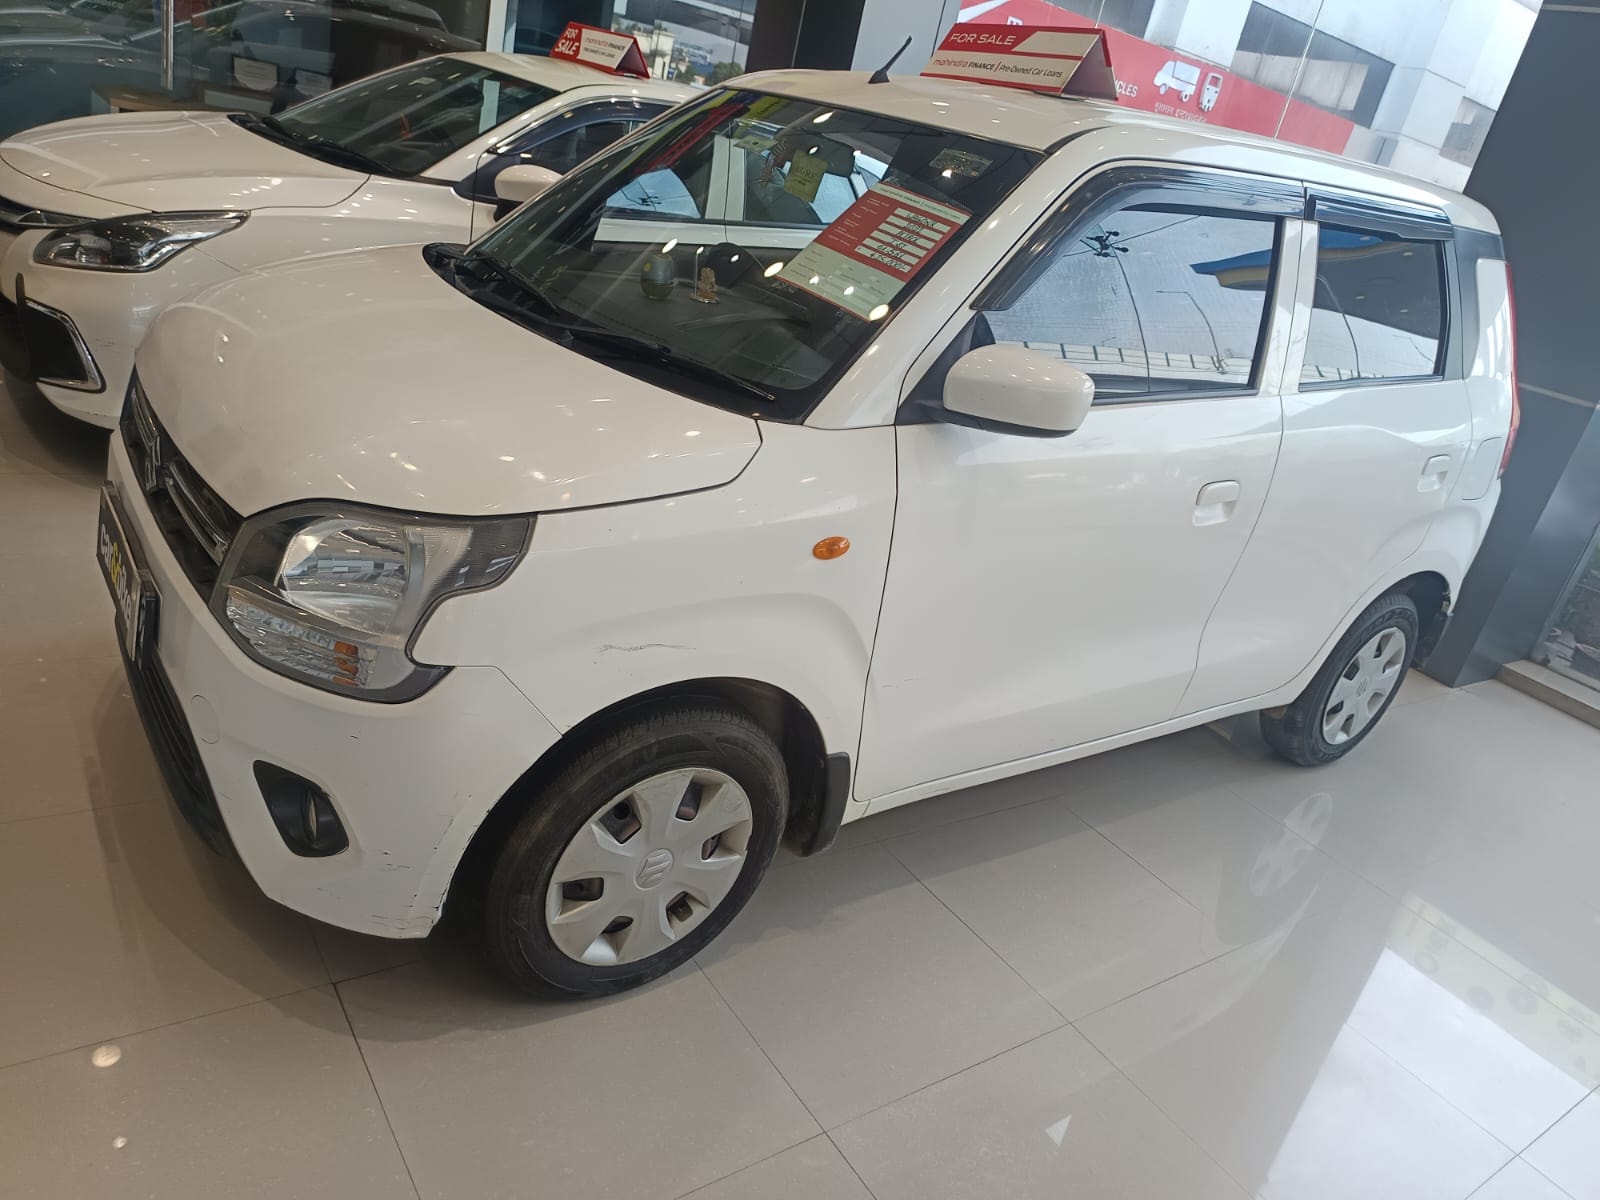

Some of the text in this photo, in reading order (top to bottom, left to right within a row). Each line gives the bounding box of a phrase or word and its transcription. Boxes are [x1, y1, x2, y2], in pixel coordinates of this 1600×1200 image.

[564, 28, 578, 38] FOR
[949, 34, 1016, 46] FOR SALE
[555, 39, 579, 55] SALE
[933, 58, 968, 68] mahindra
[968, 61, 995, 71] FINANCE
[1032, 67, 1044, 76] Car
[1043, 69, 1063, 78] Loans
[100, 523, 132, 625] car&bike
